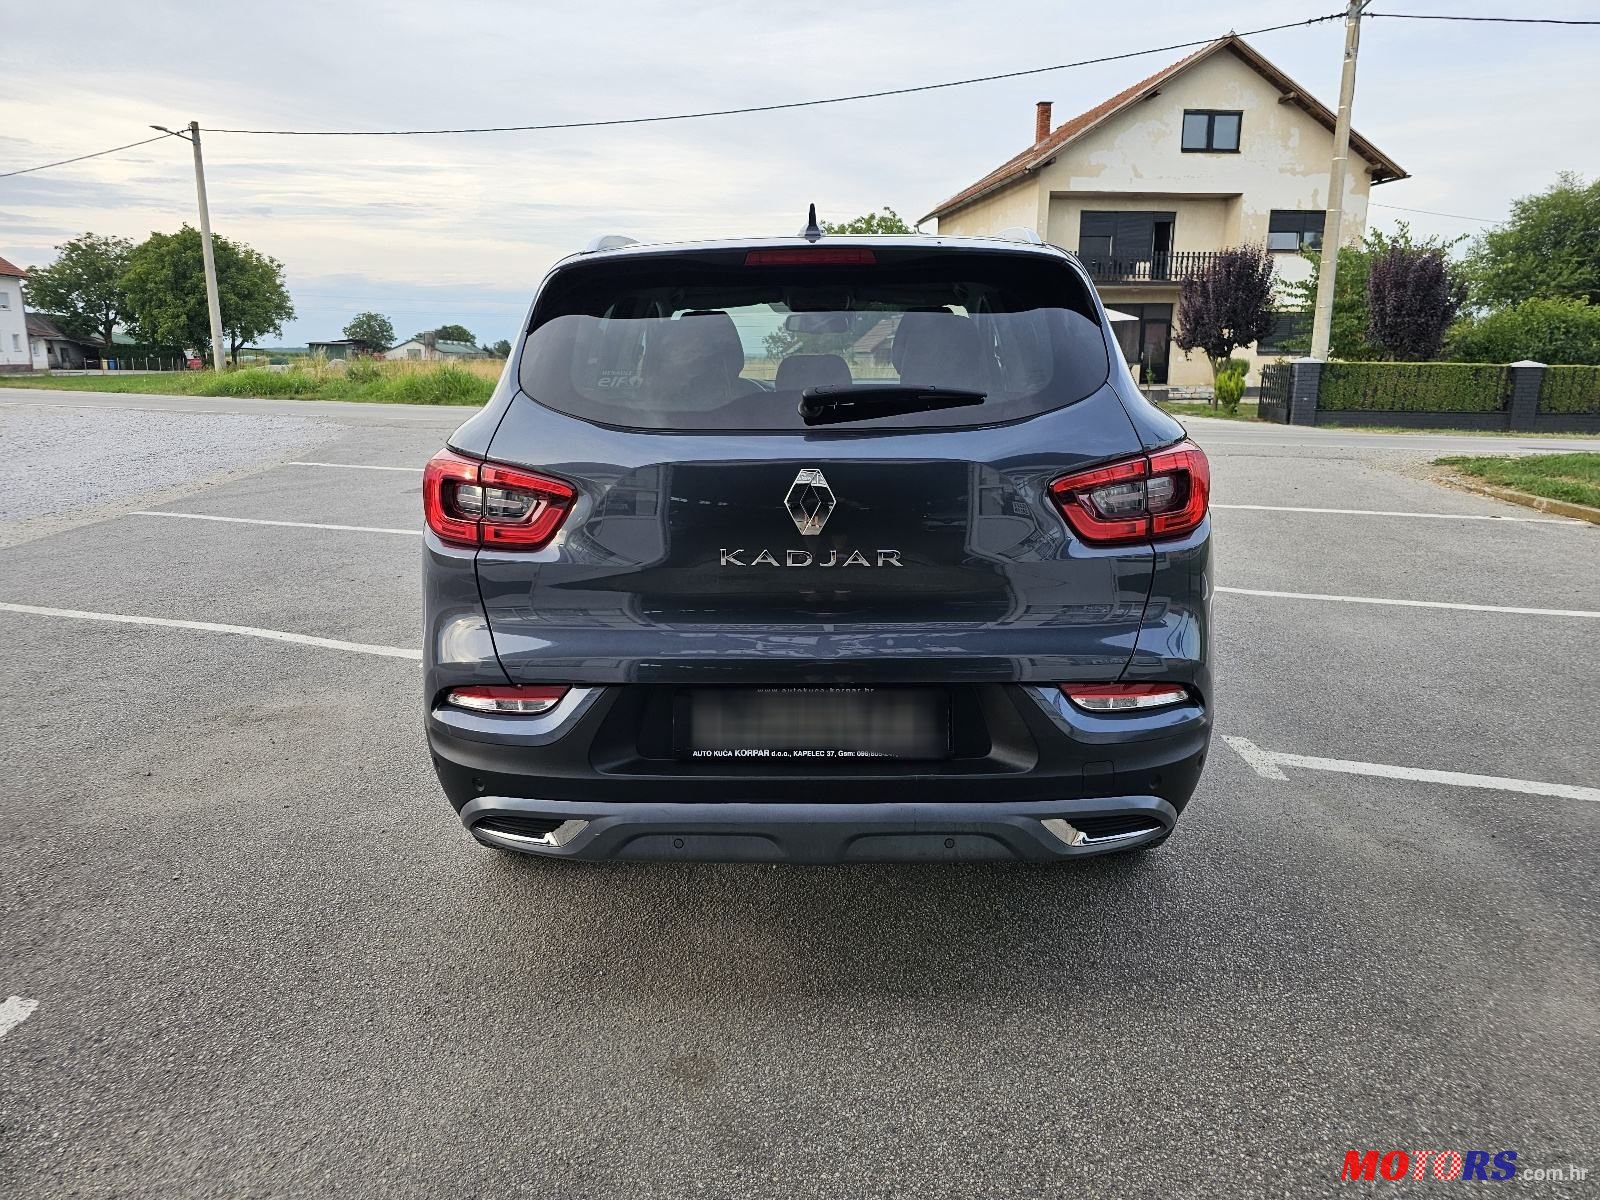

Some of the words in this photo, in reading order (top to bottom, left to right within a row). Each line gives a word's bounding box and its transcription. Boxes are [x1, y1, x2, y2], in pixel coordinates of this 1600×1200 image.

[719, 548, 904, 567] KADJAR
[713, 749, 733, 757] KUĆA
[734, 749, 770, 757] KORPAR
[771, 750, 792, 758] d.o.o.,
[826, 750, 837, 758] 37,
